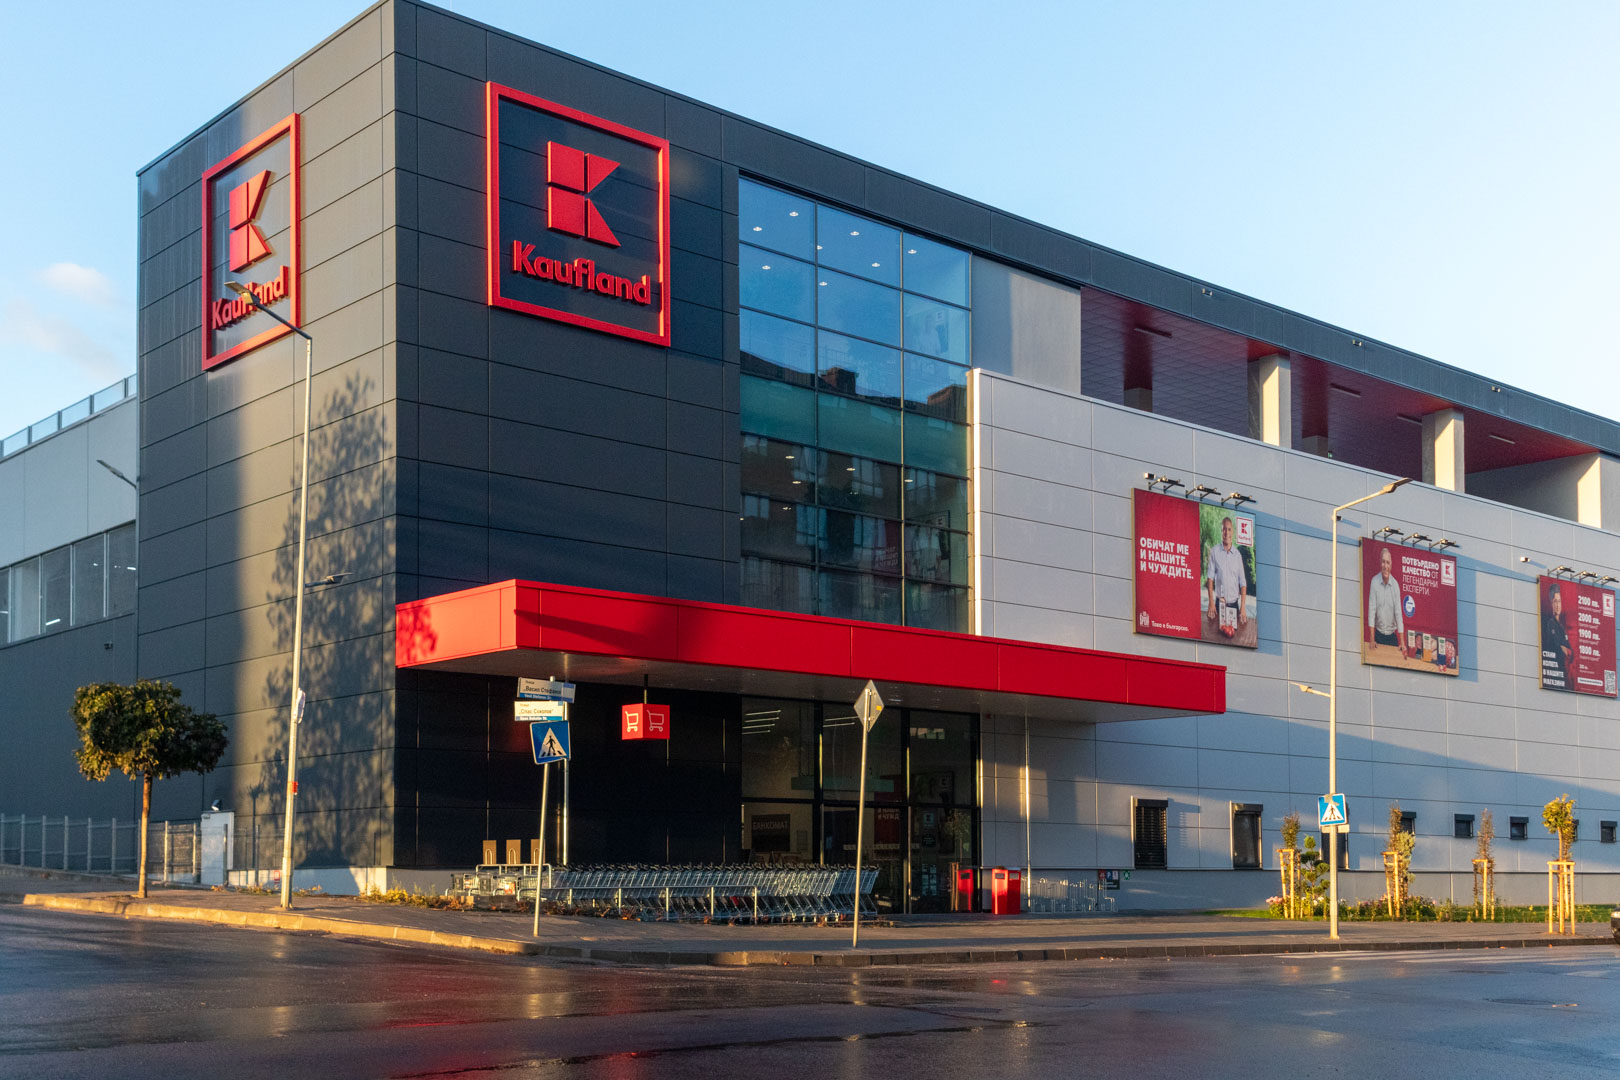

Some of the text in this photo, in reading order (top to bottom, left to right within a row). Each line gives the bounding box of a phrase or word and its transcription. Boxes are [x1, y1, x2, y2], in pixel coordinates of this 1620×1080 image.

[513, 240, 651, 305] Kaufland
[1140, 537, 1189, 555] ОБИЧАТ МЕ
[1140, 549, 1188, 568] И НАШИТЕ,
[1402, 556, 1439, 570] ПОТВЪРДЕНО
[1140, 561, 1194, 579] И ЧУЖДИТЕ.
[1402, 565, 1430, 578] КАЧЕСТВО
[1431, 571, 1439, 579] ОТ
[1402, 574, 1439, 588] ЛЕГЕНДАРНИ
[1402, 583, 1430, 596] ЕКСПЕРТИ
[1578, 595, 1591, 606] 2100
[1578, 612, 1592, 623] 2000
[1579, 628, 1591, 639] 1900
[752, 821, 788, 831] БАНКОМАТ
